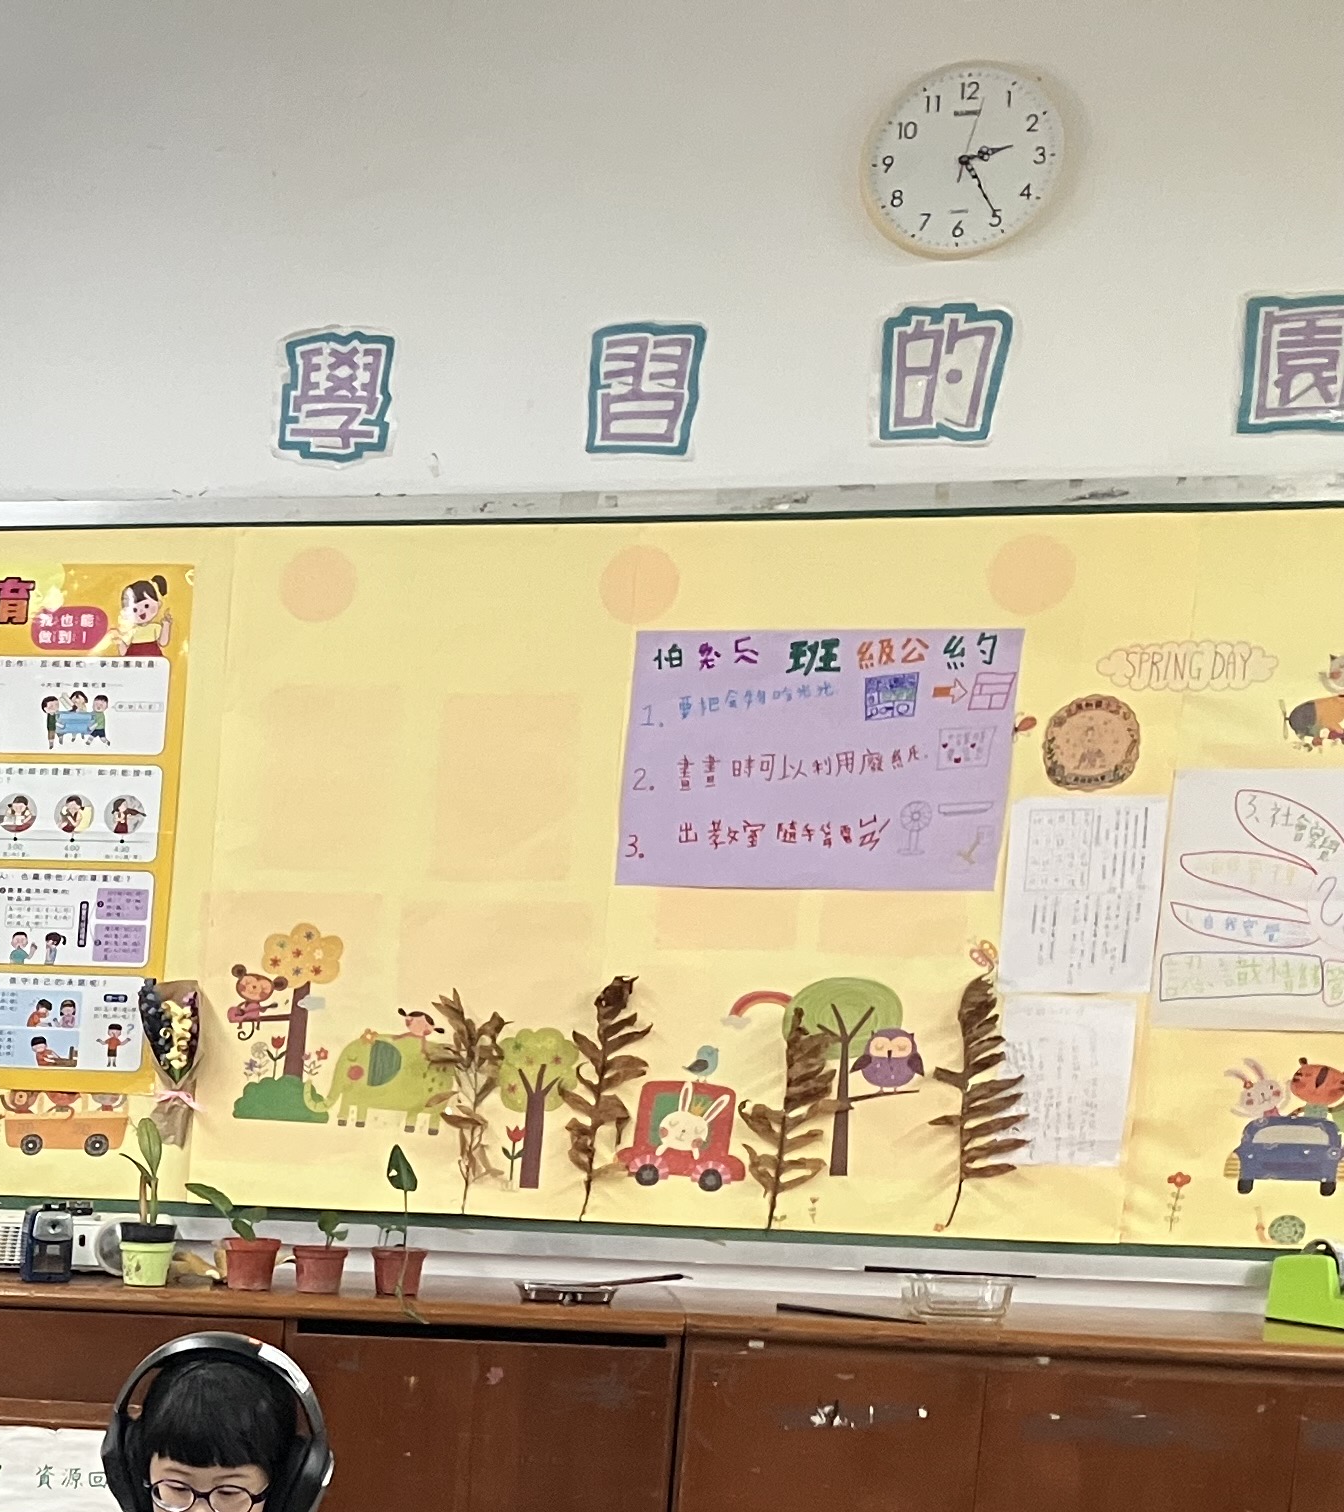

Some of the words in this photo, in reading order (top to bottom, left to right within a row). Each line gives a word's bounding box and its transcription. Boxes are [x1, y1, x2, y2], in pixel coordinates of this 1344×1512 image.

[961, 81, 980, 101] 12
[1006, 90, 1012, 108] 1
[925, 95, 941, 113] 11
[897, 121, 918, 140] 10
[1026, 113, 1039, 132] 2
[881, 155, 894, 174] 9
[1032, 146, 1047, 165] 3
[890, 189, 904, 208] 8
[1019, 183, 1032, 200] 4
[919, 212, 932, 231] 7
[988, 208, 1002, 228] 5
[951, 220, 964, 238] 6
[284, 340, 388, 455] 學
[596, 332, 696, 447] 習
[889, 314, 1000, 436] 的
[1125, 651, 1204, 684] SPRING
[1211, 649, 1253, 681] DAY
